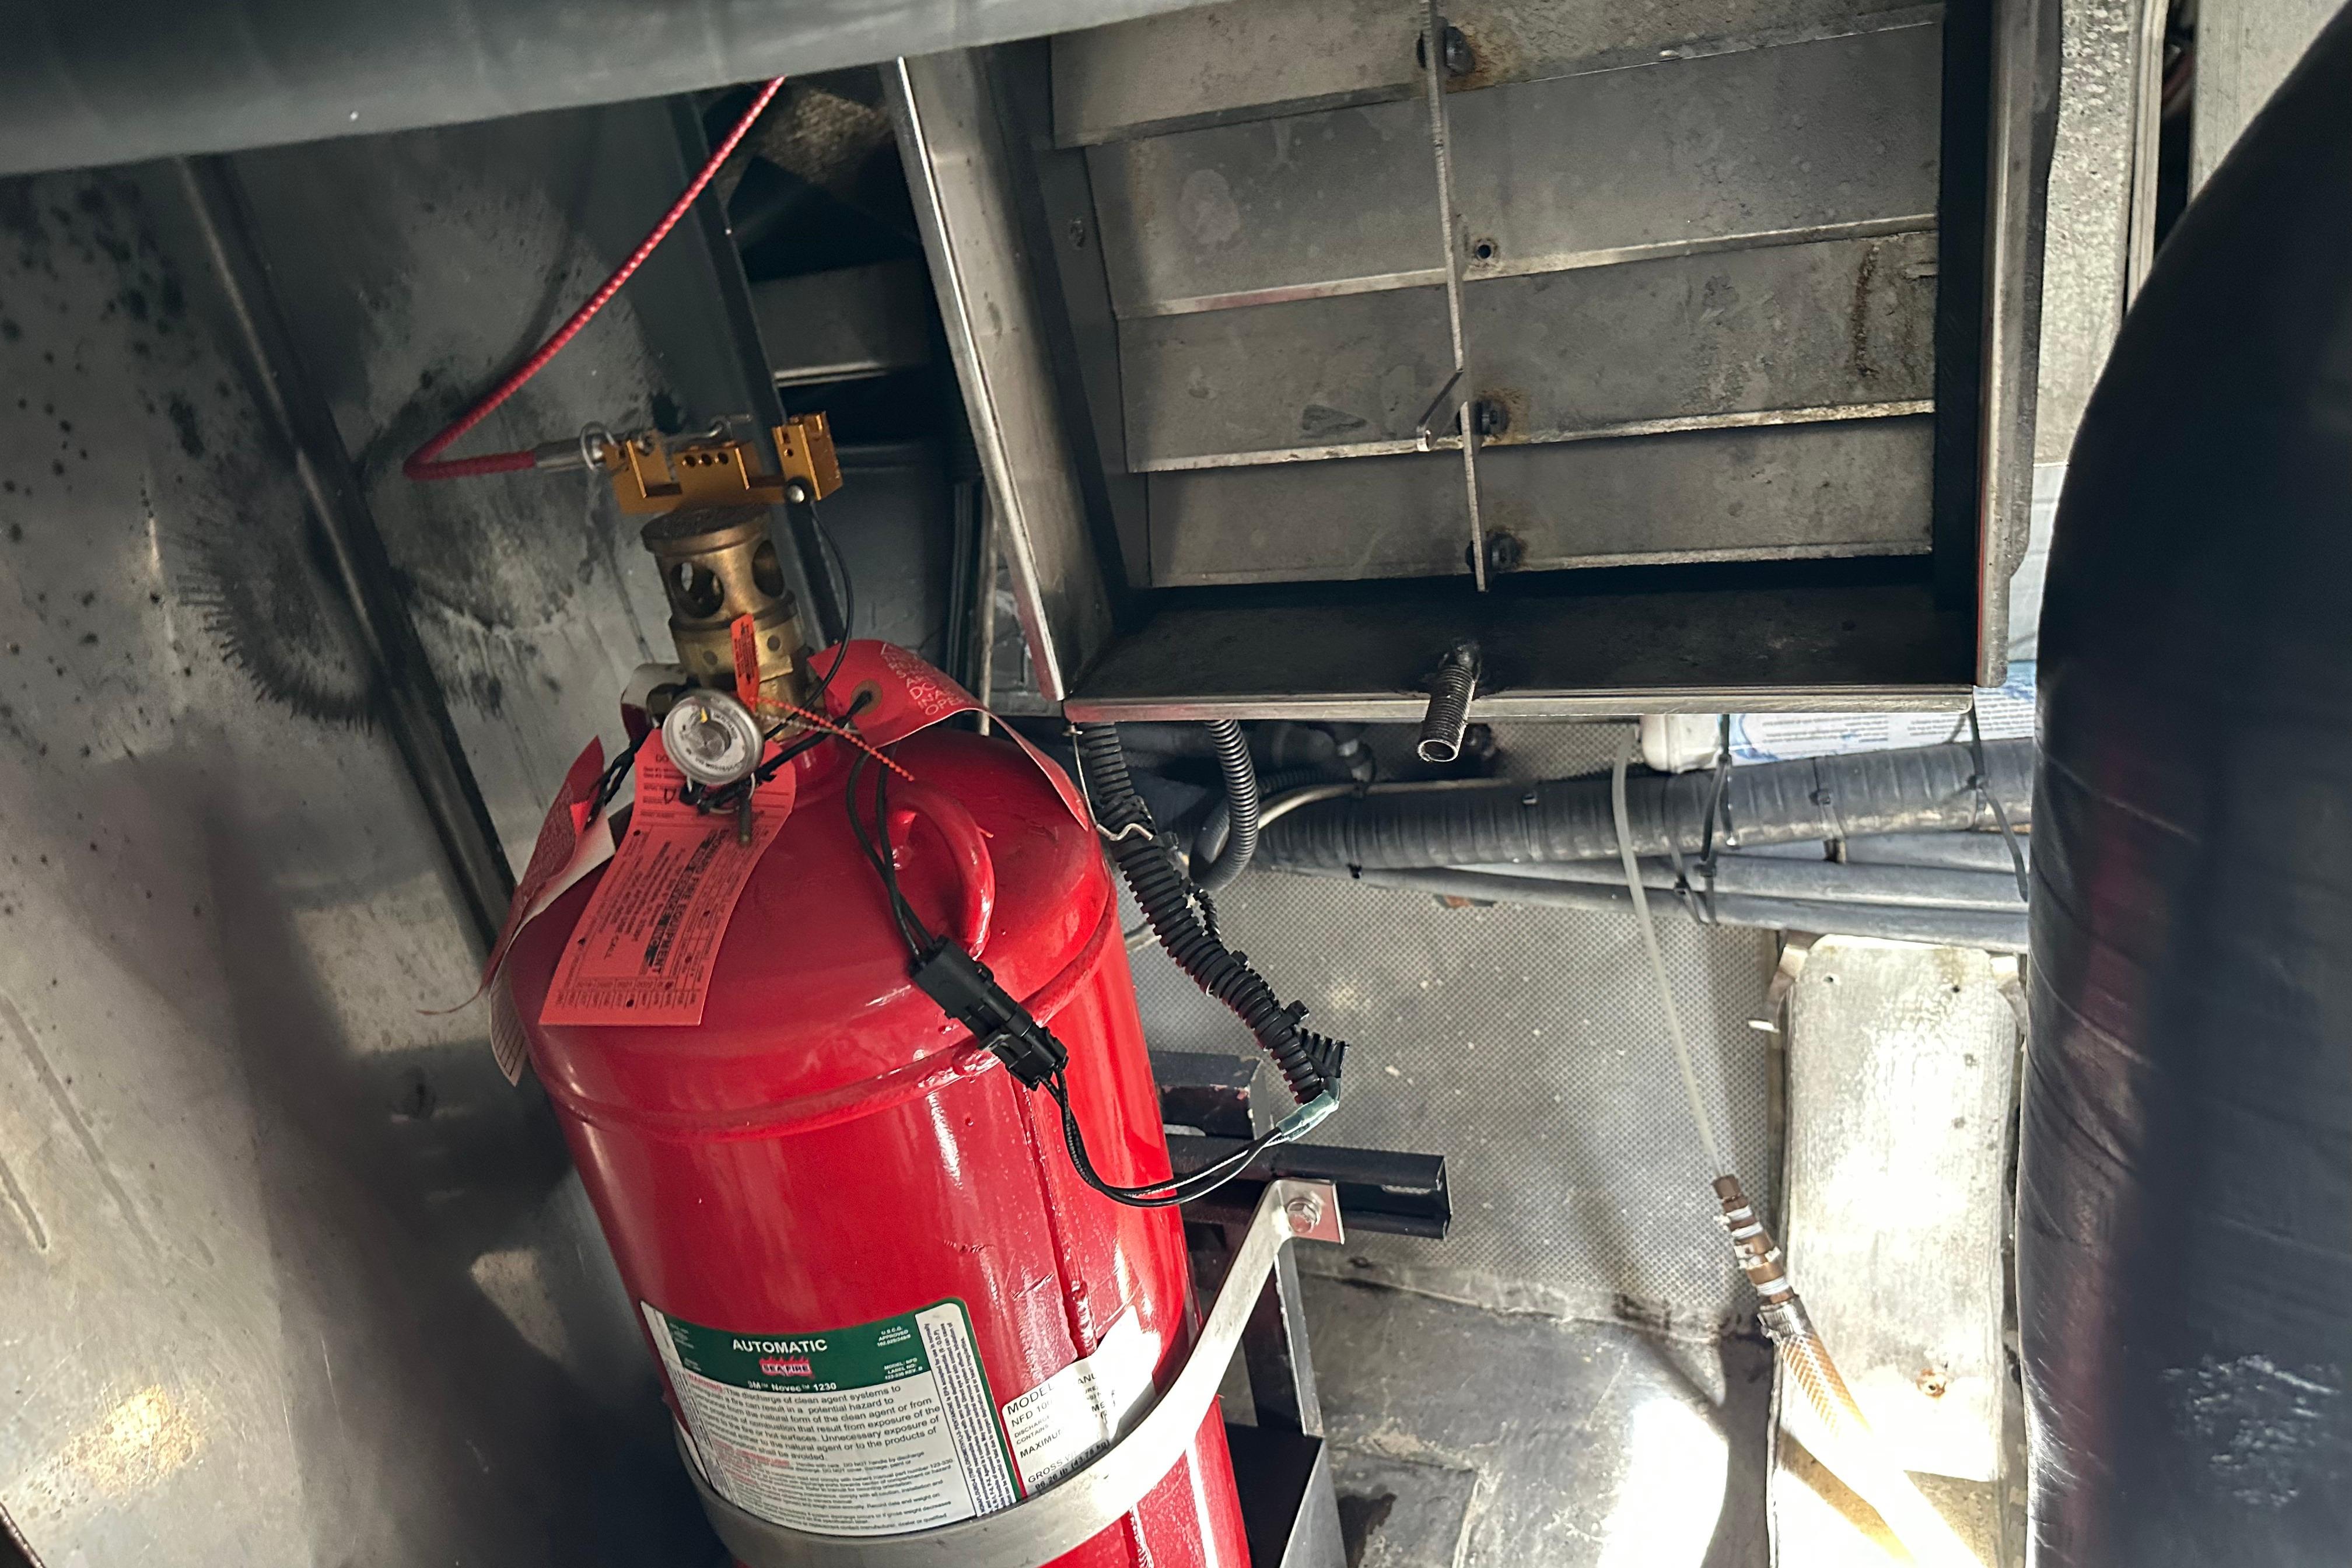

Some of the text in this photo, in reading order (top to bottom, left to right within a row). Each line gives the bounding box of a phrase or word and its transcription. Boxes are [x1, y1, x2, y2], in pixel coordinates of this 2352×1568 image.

[652, 876, 701, 975] FIRE EQUIPMENT
[879, 1329, 909, 1341] APPROVED
[923, 1322, 935, 1343] normally
[948, 1327, 959, 1350] Inhalation
[733, 1339, 828, 1353] AUTOMATIC
[946, 1346, 956, 1364] contact
[936, 1365, 947, 1385] accepted
[961, 1367, 970, 1384] system
[813, 1382, 836, 1391] 1230
[947, 1374, 958, 1395] depletion
[966, 1384, 975, 1402] nervous
[742, 1392, 781, 1404] discharge
[821, 1394, 848, 1405] agent
[850, 1388, 889, 1401] systems
[958, 1388, 967, 1402] Direct
[1007, 1383, 1055, 1415] MODEL
[746, 1409, 758, 1418] the
[760, 1413, 789, 1422] natural
[841, 1413, 866, 1422] clean
[869, 1407, 895, 1419] agent
[910, 1398, 932, 1409] from
[808, 1405, 847, 1415] potential
[849, 1399, 881, 1410] hazard
[868, 1415, 911, 1427] exposure
[914, 1409, 923, 1418] of
[925, 1406, 940, 1415] the
[1012, 1410, 1033, 1427] NFD
[821, 1431, 881, 1441] Unnecessary
[884, 1420, 928, 1434] exposure
[930, 1415, 940, 1423] of
[964, 1429, 972, 1442] agent
[979, 1431, 988, 1441] May
[1016, 1423, 1049, 1445] CONTAINS
[817, 1444, 842, 1452] agent
[885, 1431, 925, 1447] products
[928, 1426, 937, 1435] of
[791, 1452, 827, 1461] avoided.
[897, 1451, 924, 1461] discharge
[932, 1464, 951, 1474] hazard
[1028, 1458, 1063, 1483] GROSS
